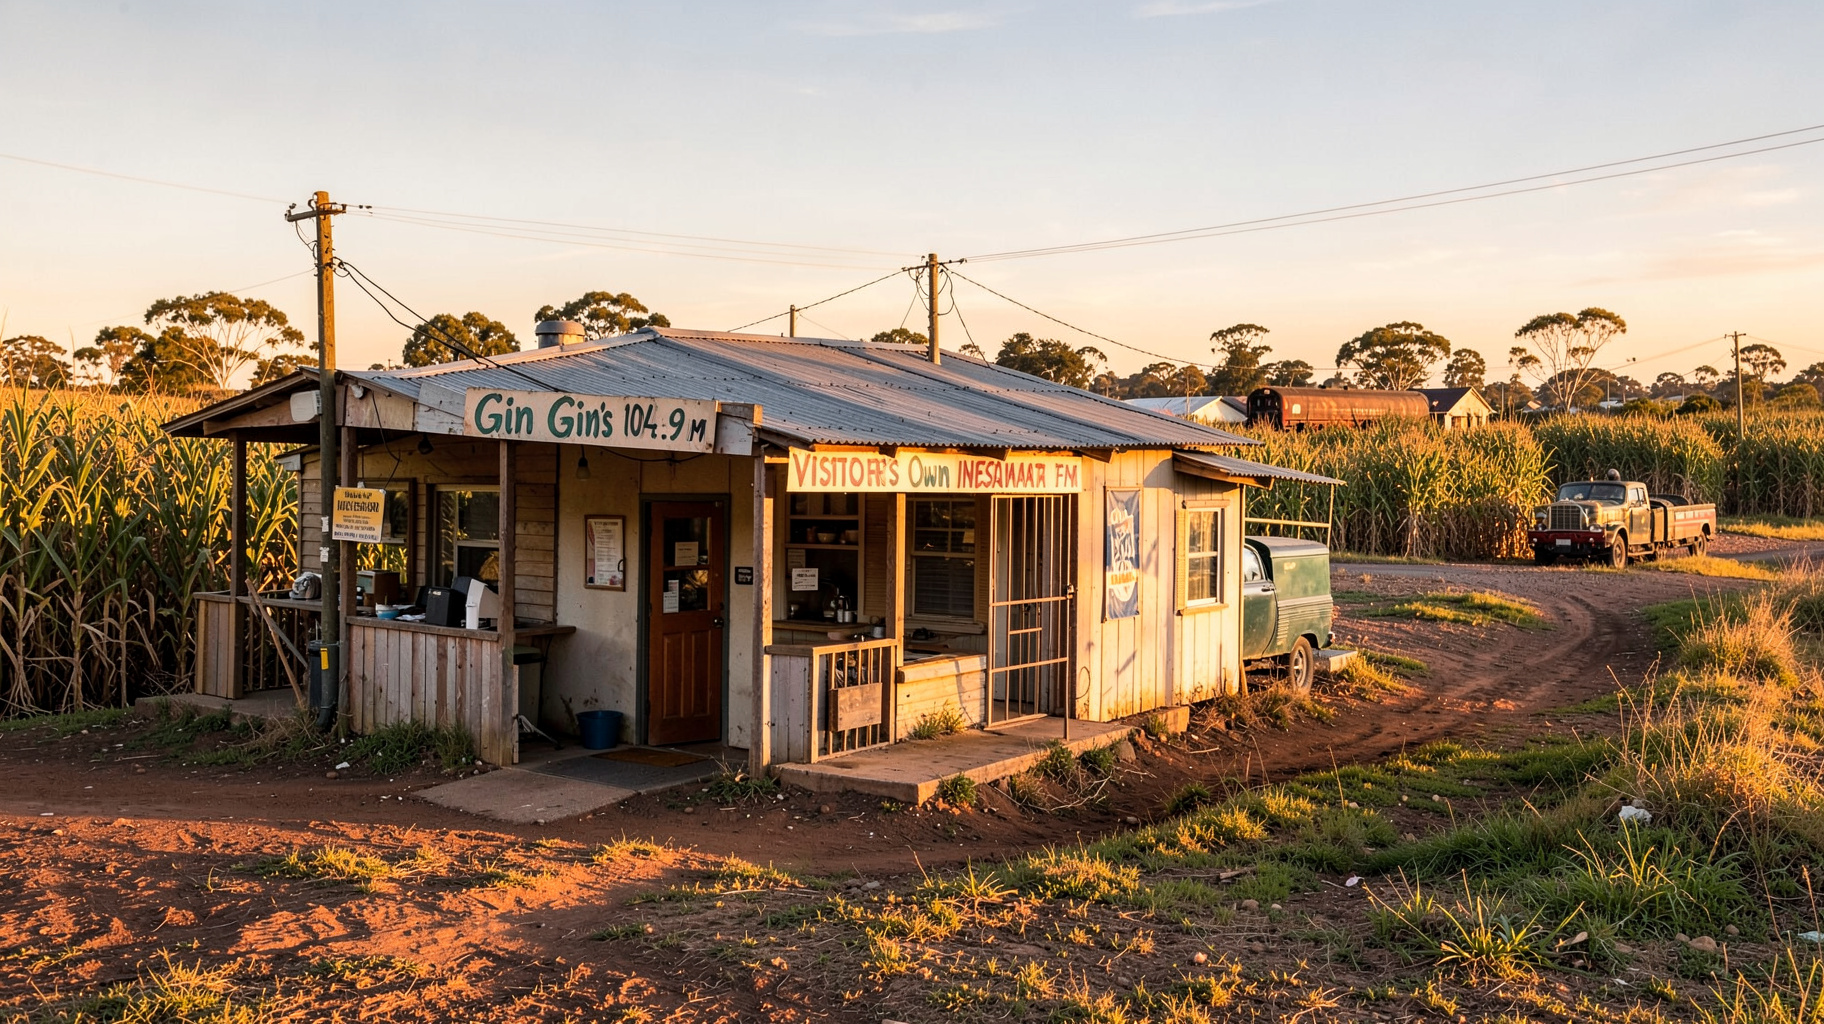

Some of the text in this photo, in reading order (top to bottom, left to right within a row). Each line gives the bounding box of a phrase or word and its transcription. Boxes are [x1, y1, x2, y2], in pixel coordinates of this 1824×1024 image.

[474, 392, 534, 435] Gin
[547, 395, 613, 439] Gin's
[624, 403, 685, 441] 104.9
[908, 455, 950, 489] Own
[1055, 462, 1078, 488] FM
